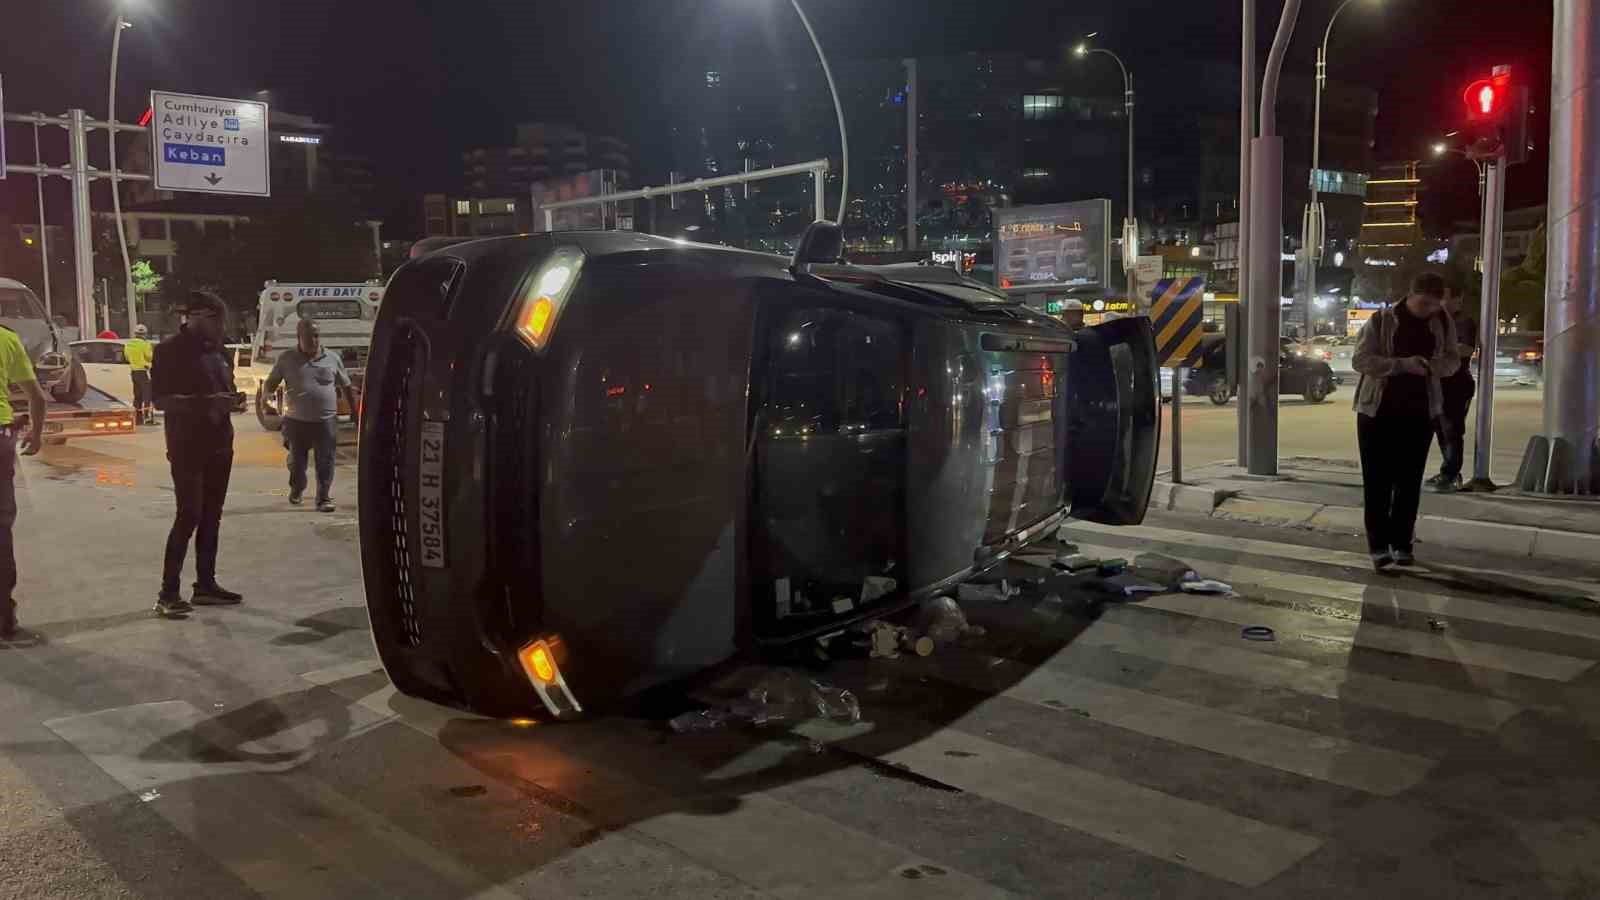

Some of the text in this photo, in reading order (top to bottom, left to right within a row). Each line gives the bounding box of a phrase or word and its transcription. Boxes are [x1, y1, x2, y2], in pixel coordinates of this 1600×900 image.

[164, 100, 236, 117] Cumhuriyet
[163, 113, 218, 130] Adliye
[163, 128, 249, 146] Çaydaçıra
[168, 147, 222, 162] Keban
[298, 288, 329, 297] KEKE
[422, 439, 441, 464] 21
[422, 473, 440, 488] H
[422, 497, 441, 561] 37584
